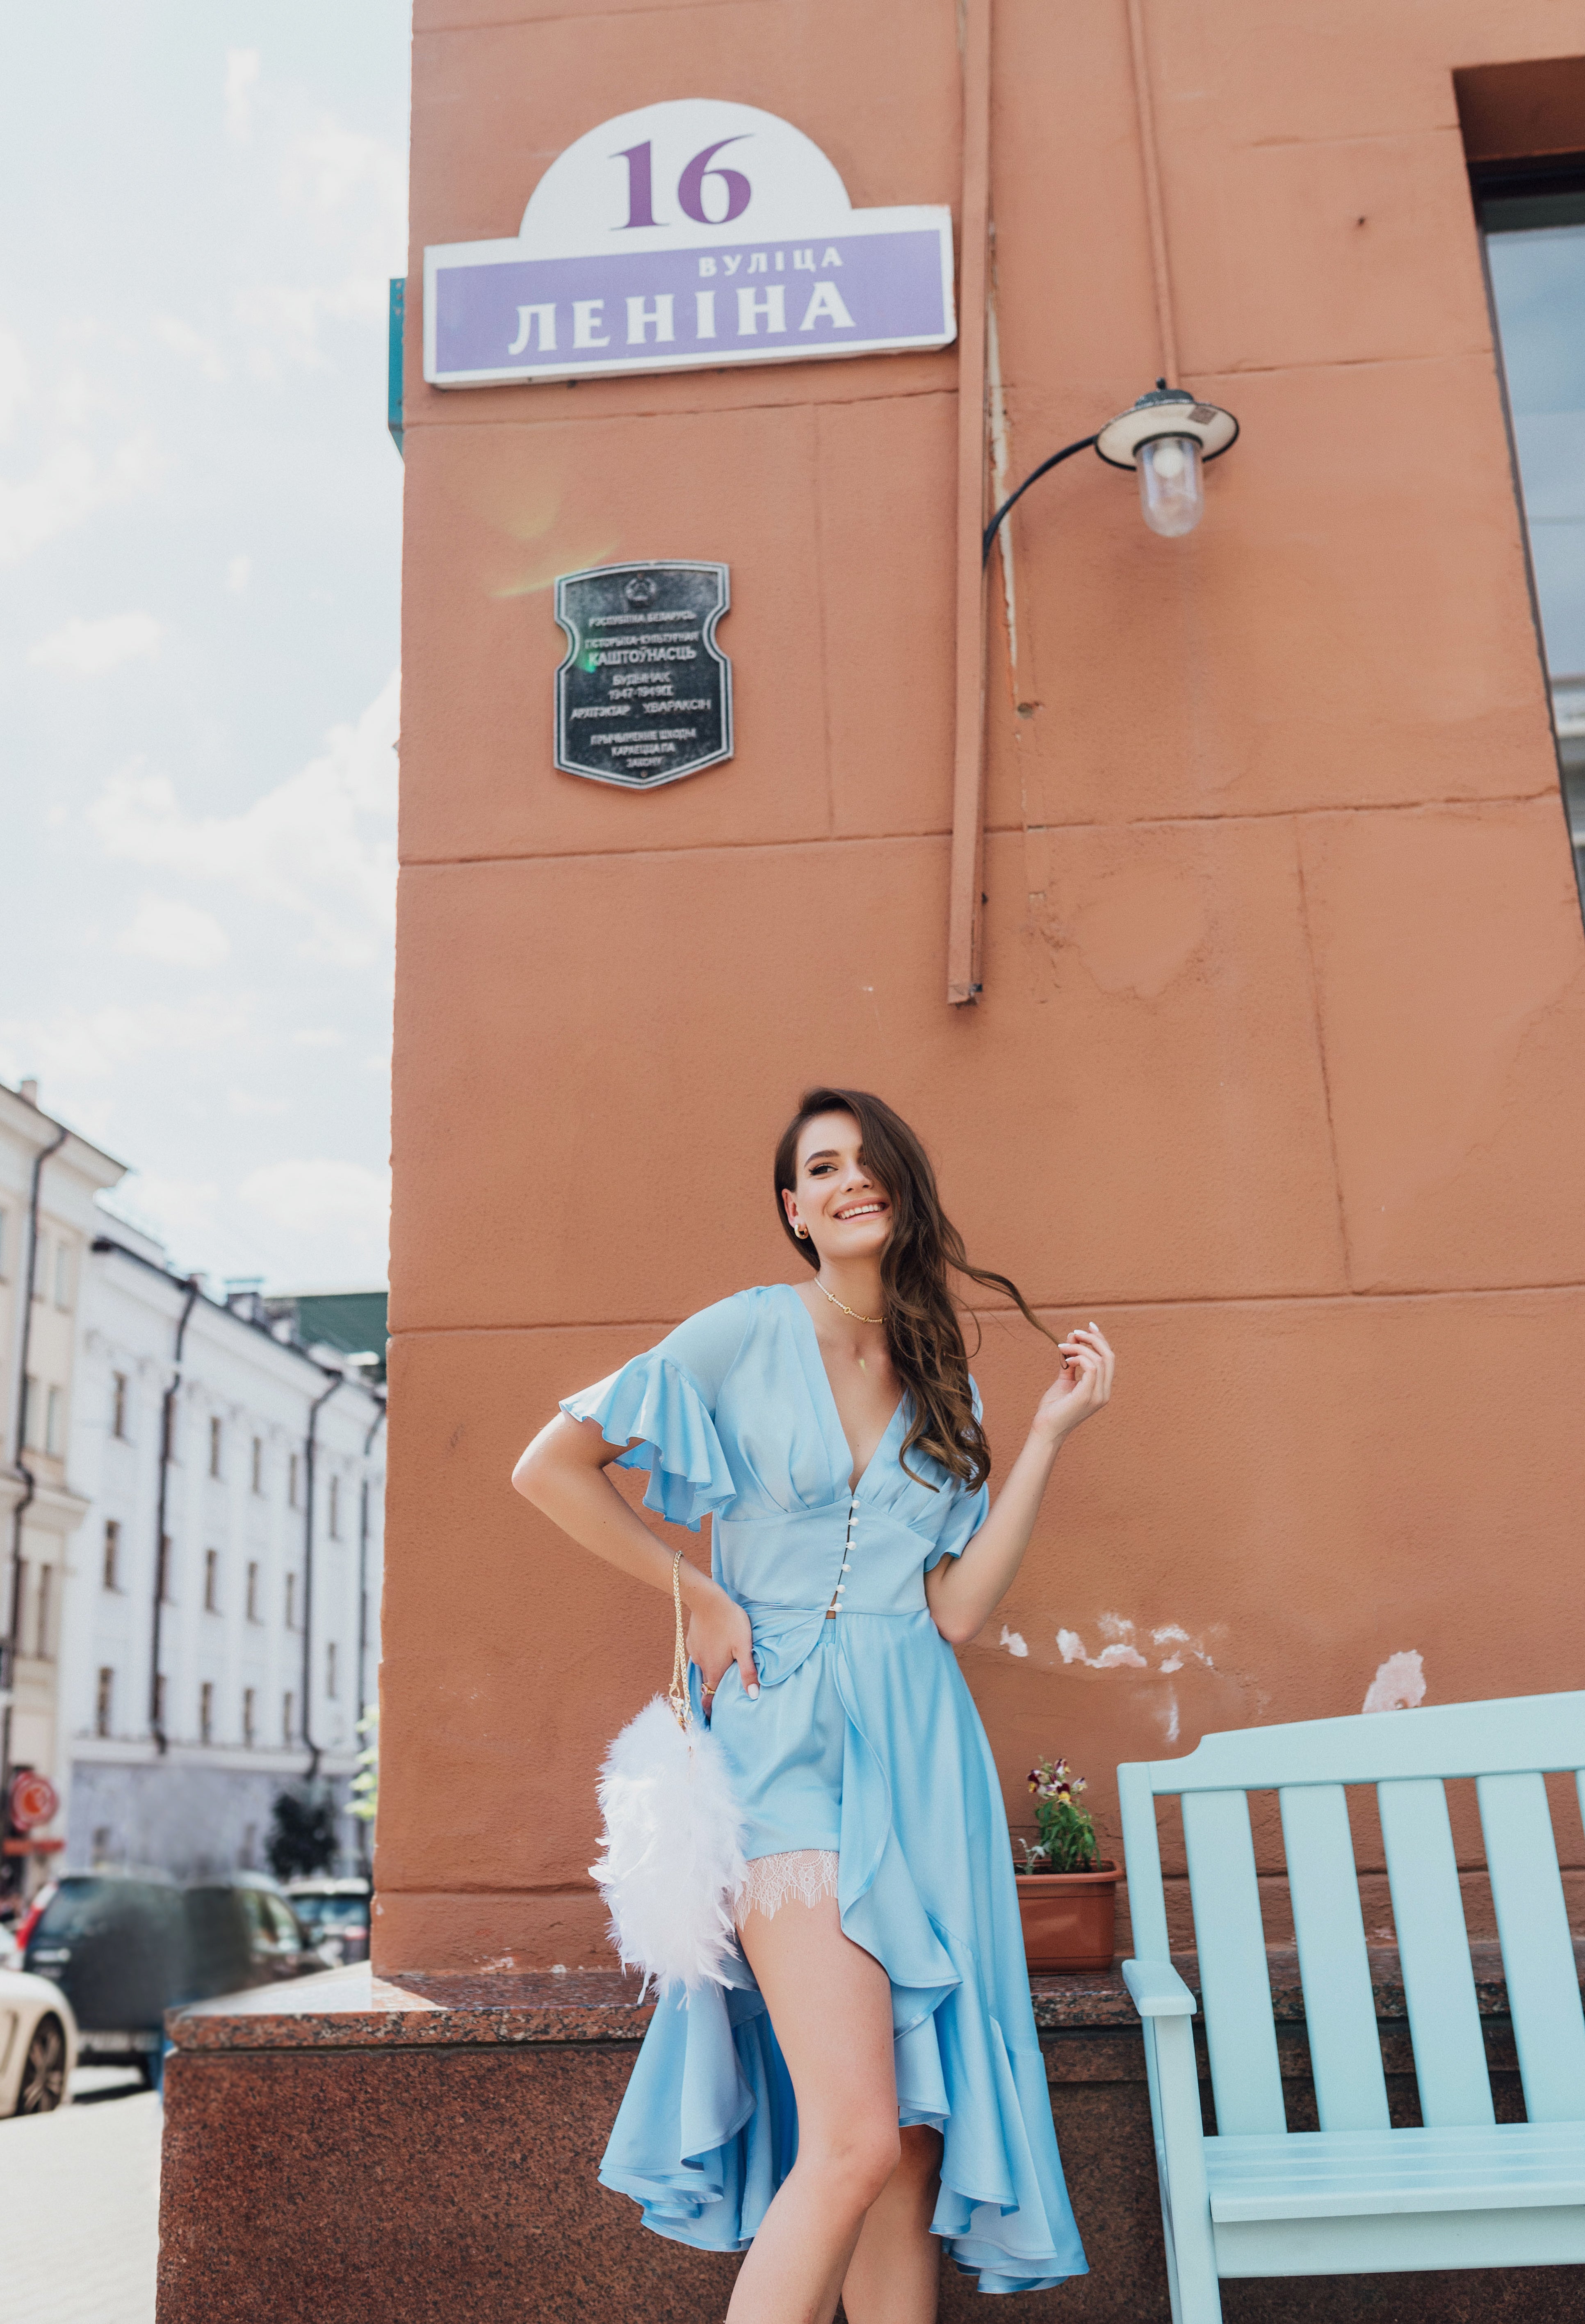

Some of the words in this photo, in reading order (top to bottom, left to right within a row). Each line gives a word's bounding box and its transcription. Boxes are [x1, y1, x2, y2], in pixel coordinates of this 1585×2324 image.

[608, 133, 755, 231] 16
[698, 246, 842, 277] ВУЛІЦА
[508, 281, 856, 355] ЛЕНІНА
[588, 645, 697, 667] КАШТОЎНАСЦЬ
